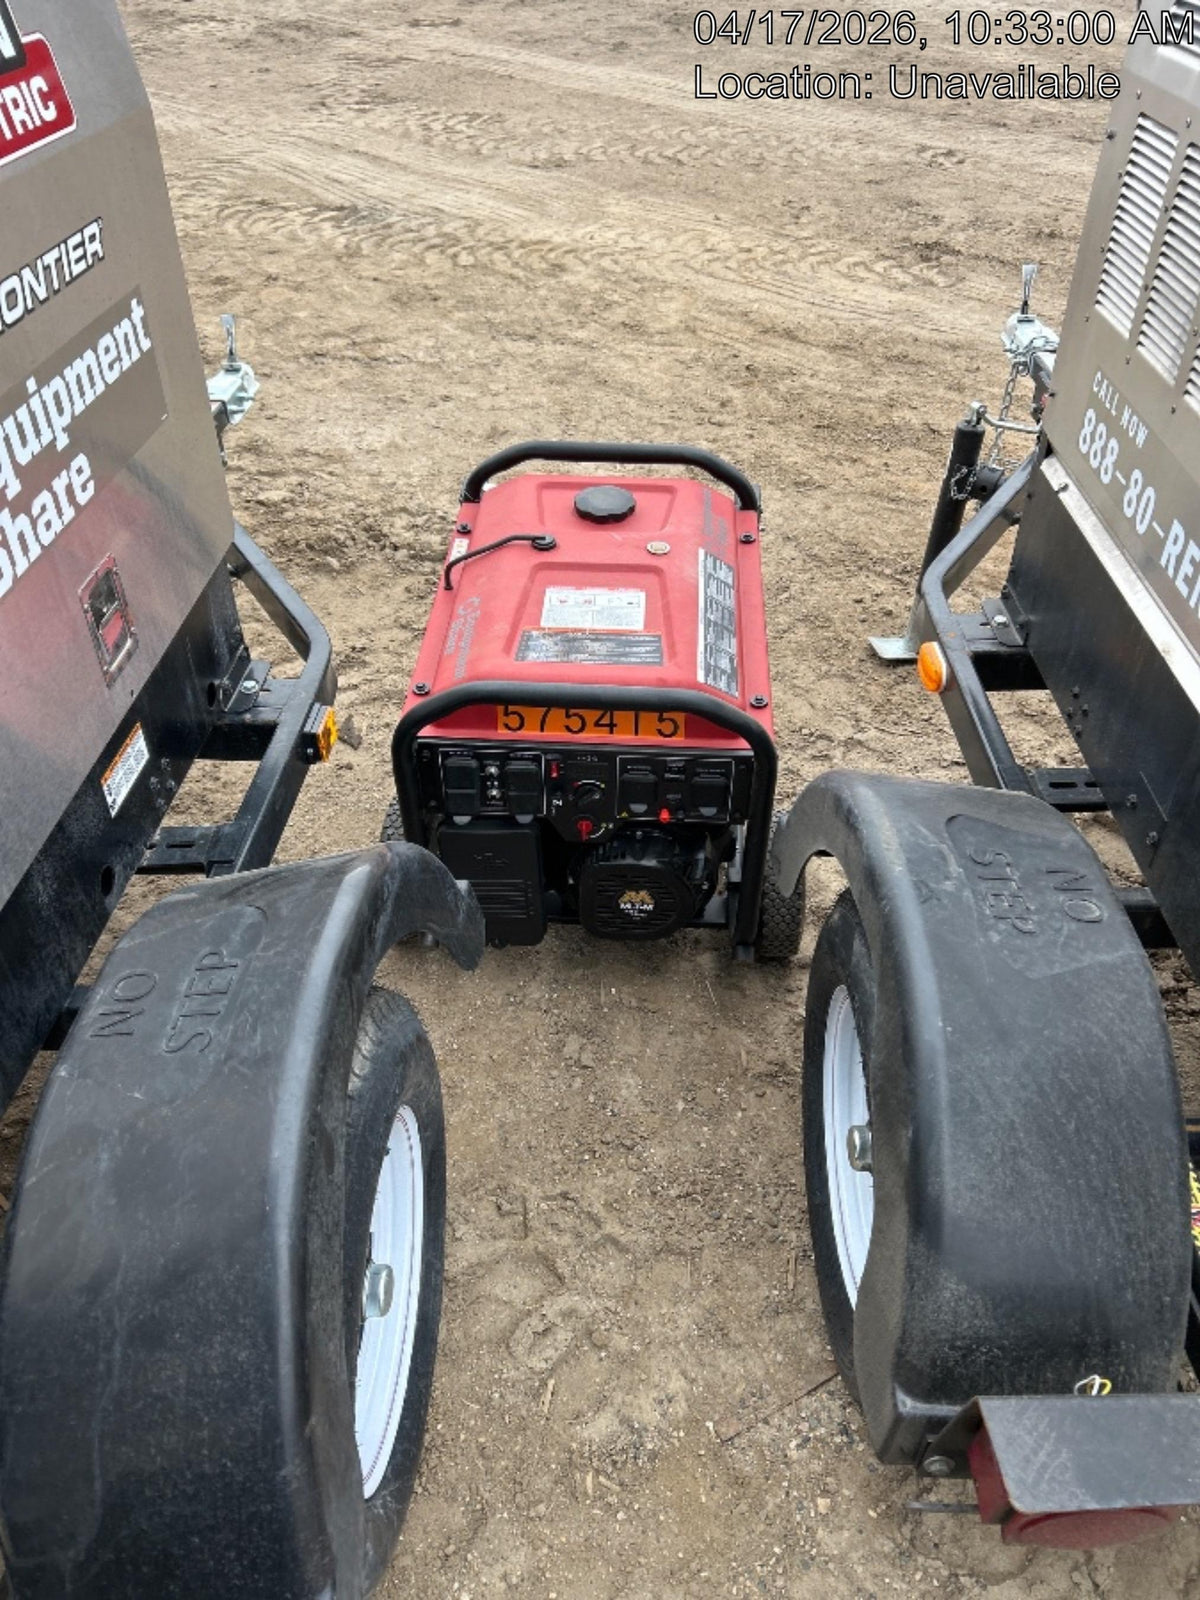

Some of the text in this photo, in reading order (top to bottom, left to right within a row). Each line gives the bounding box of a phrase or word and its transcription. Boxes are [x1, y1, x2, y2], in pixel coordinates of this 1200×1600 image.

[0, 220, 104, 332] ONTIER
[1092, 370, 1149, 449] CALL NOW
[502, 704, 681, 739] 575415
[88, 967, 160, 1039] NO
[162, 949, 240, 1056] STEP
